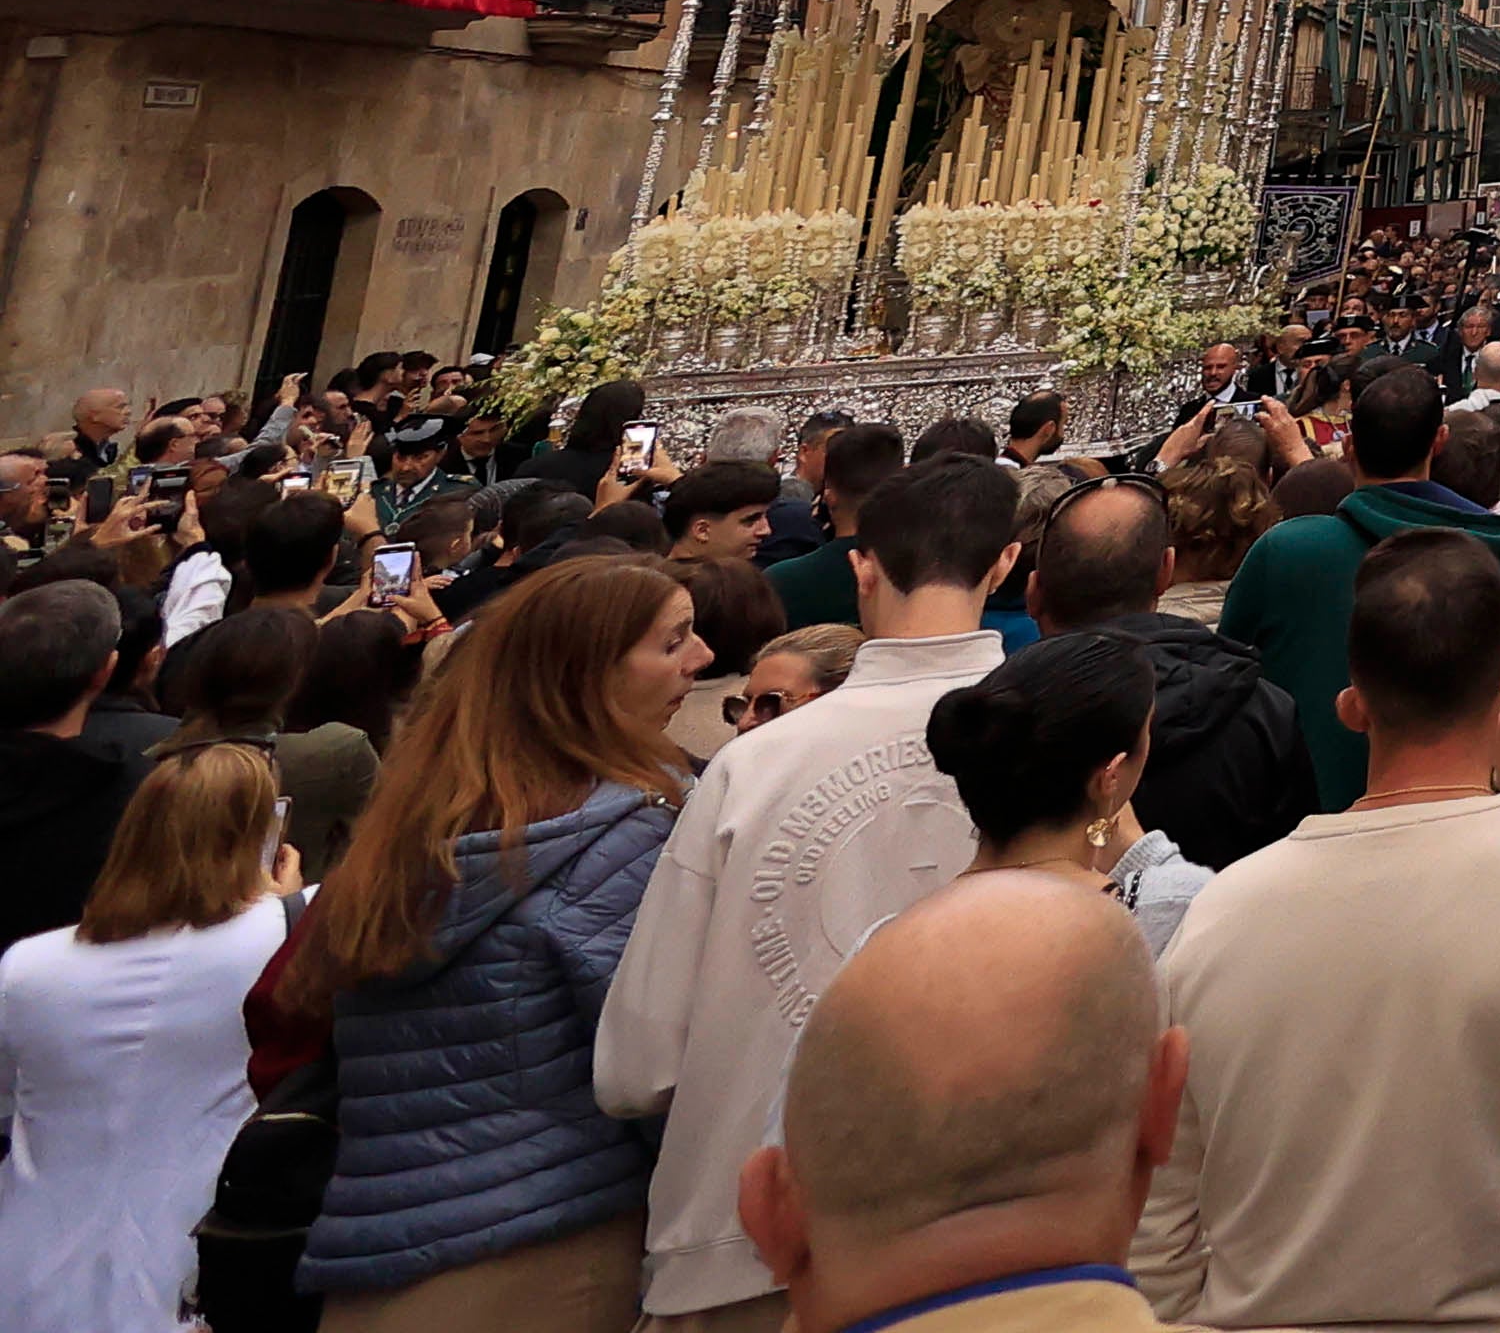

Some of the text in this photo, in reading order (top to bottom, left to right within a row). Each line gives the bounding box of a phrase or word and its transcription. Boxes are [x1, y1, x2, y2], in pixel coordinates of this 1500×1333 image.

[750, 840, 796, 903] OLD
[795, 781, 892, 885] OLD FEELING
